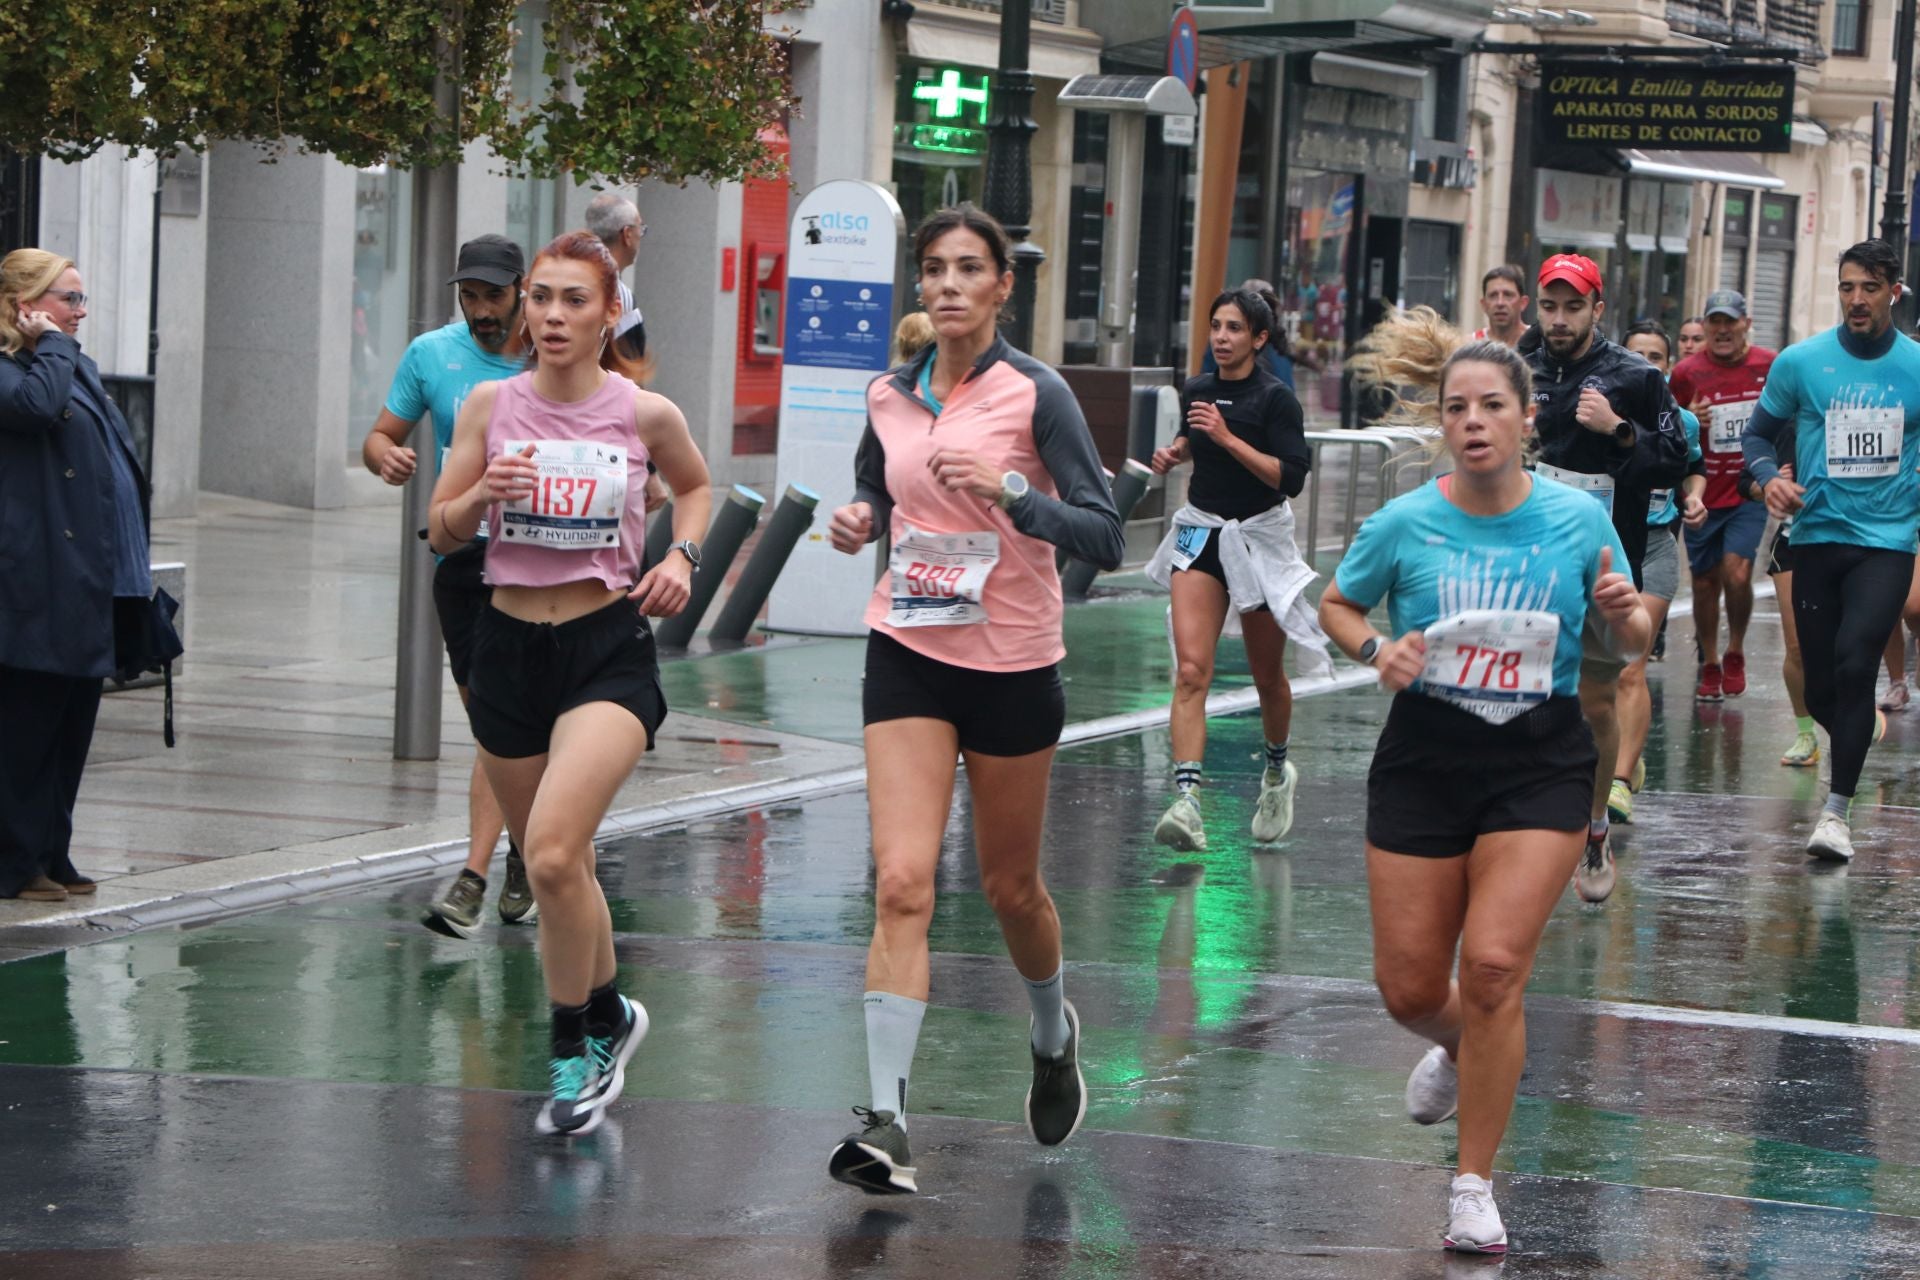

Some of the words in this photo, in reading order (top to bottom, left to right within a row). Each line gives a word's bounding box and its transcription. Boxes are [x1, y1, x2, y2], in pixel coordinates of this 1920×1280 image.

[1549, 75, 1619, 95] OPTICA
[1628, 78, 1692, 97] Emilia
[1701, 79, 1785, 98] Barriada
[1553, 102, 1645, 118] APARATOS
[1651, 104, 1697, 119] PARA
[1705, 105, 1778, 121] SORDOS
[1567, 124, 1631, 139] LENTES
[1638, 126, 1662, 140] DE
[1669, 127, 1761, 143] CONTACTO
[821, 210, 869, 231] alsa
[1847, 432, 1882, 457] 1181
[531, 476, 598, 517] 1137
[545, 529, 601, 541] HYUNDAI
[905, 561, 967, 597] 989
[1456, 644, 1522, 689] 778
